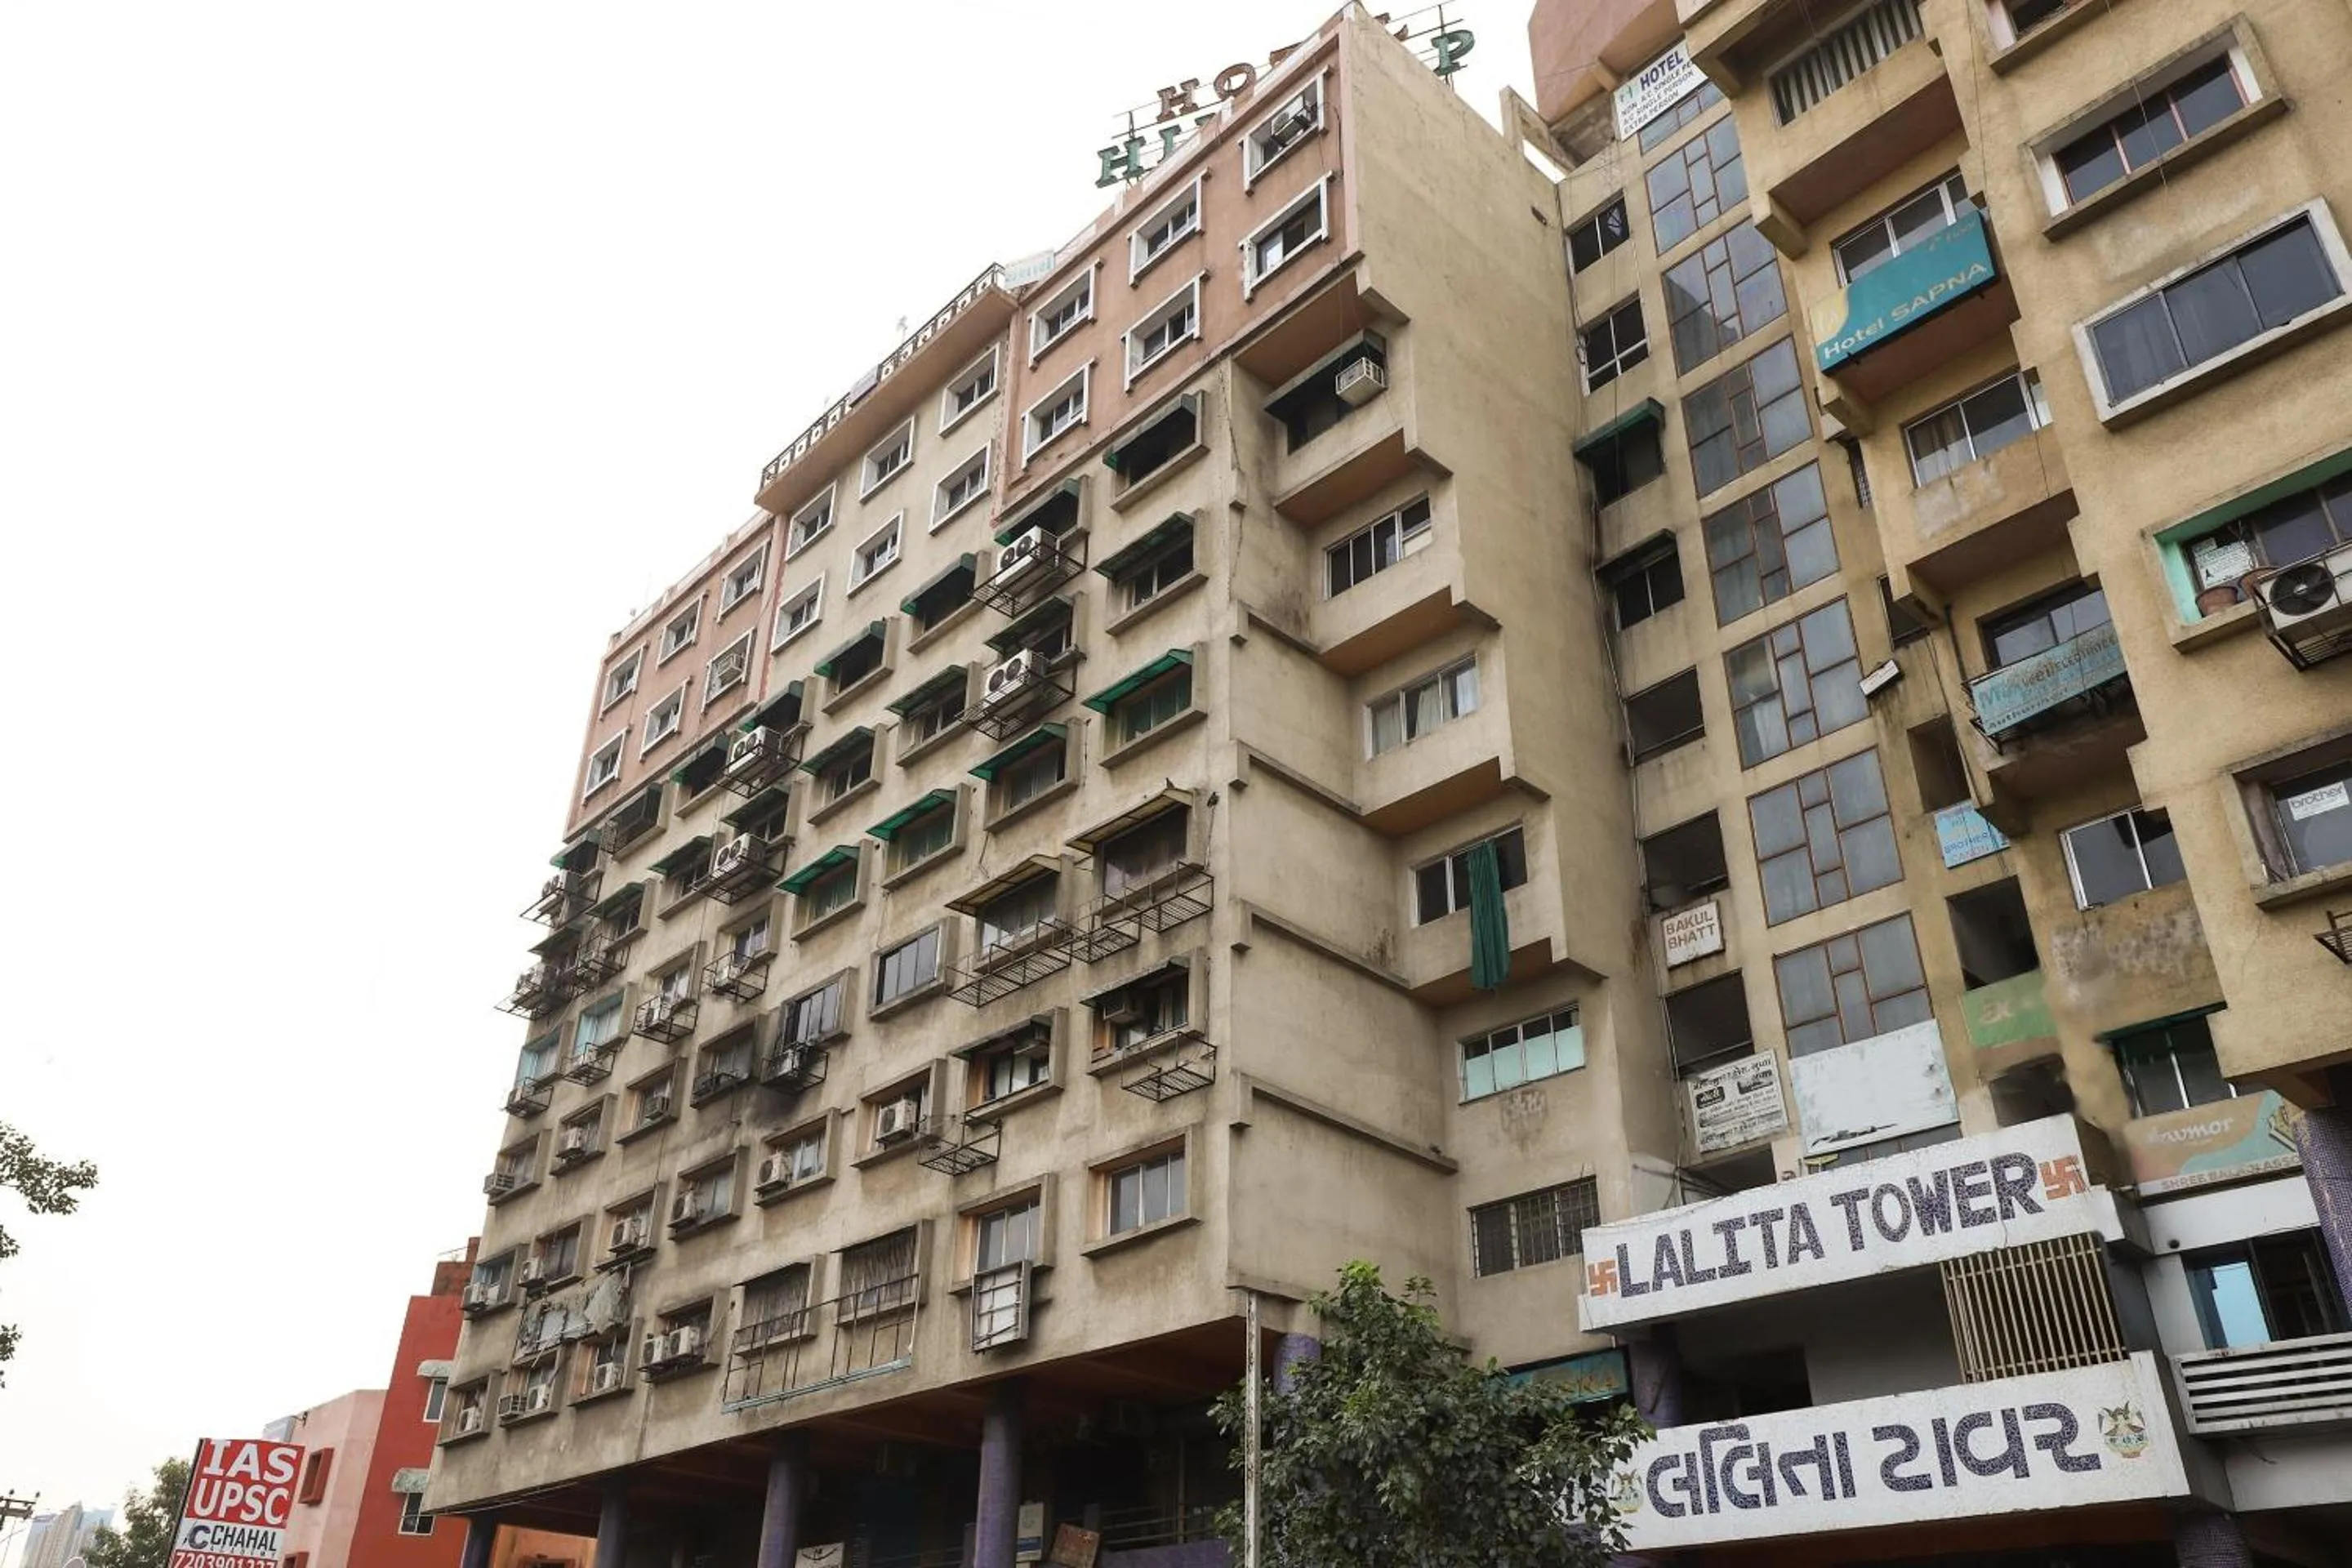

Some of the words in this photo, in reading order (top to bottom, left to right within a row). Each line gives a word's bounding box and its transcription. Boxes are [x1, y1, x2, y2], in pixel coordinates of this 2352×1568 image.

[1640, 51, 1683, 91] HOTEL
[1824, 318, 1884, 359] Hotel
[1891, 262, 1987, 322] SAPNA
[1666, 911, 1713, 935] BAKUL
[1668, 923, 1715, 949] BHATT
[1616, 1202, 1825, 1297] LALITA
[1829, 1152, 2045, 1252] TOWER
[203, 1438, 297, 1484] IAS
[1646, 1423, 1856, 1518] લલિતા
[1872, 1403, 2102, 1492] ટાવર
[194, 1478, 289, 1525] UPSC
[211, 1525, 277, 1552] CHAHAL
